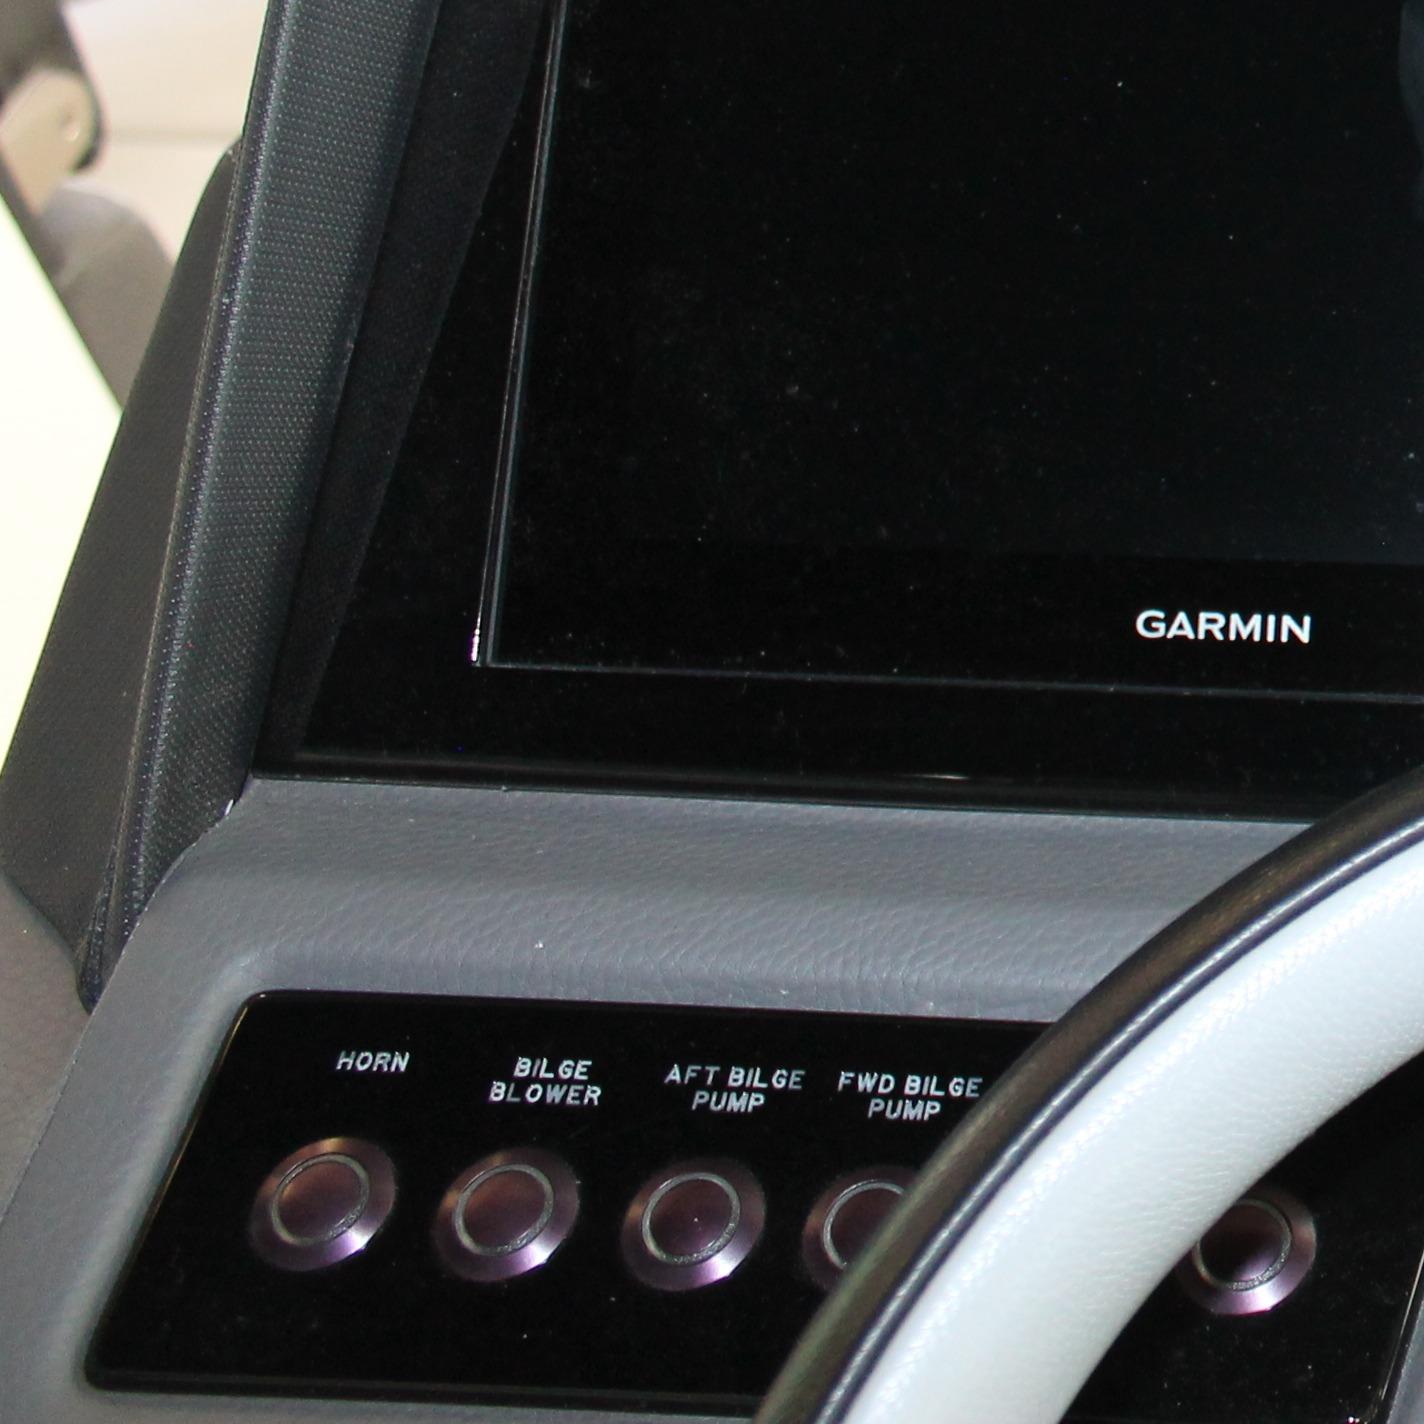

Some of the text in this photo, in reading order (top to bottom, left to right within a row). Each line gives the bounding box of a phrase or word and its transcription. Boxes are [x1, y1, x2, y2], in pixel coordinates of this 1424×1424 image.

[1135, 609, 1312, 644] GARMIN
[335, 1050, 410, 1073] HORN
[512, 1056, 593, 1081] BILGE
[663, 1063, 806, 1090] AFT BILGE
[837, 1070, 983, 1098] FWD BILGE
[488, 1080, 602, 1106] BLOWER
[691, 1090, 766, 1113] PUMP
[867, 1098, 941, 1121] PUMP
